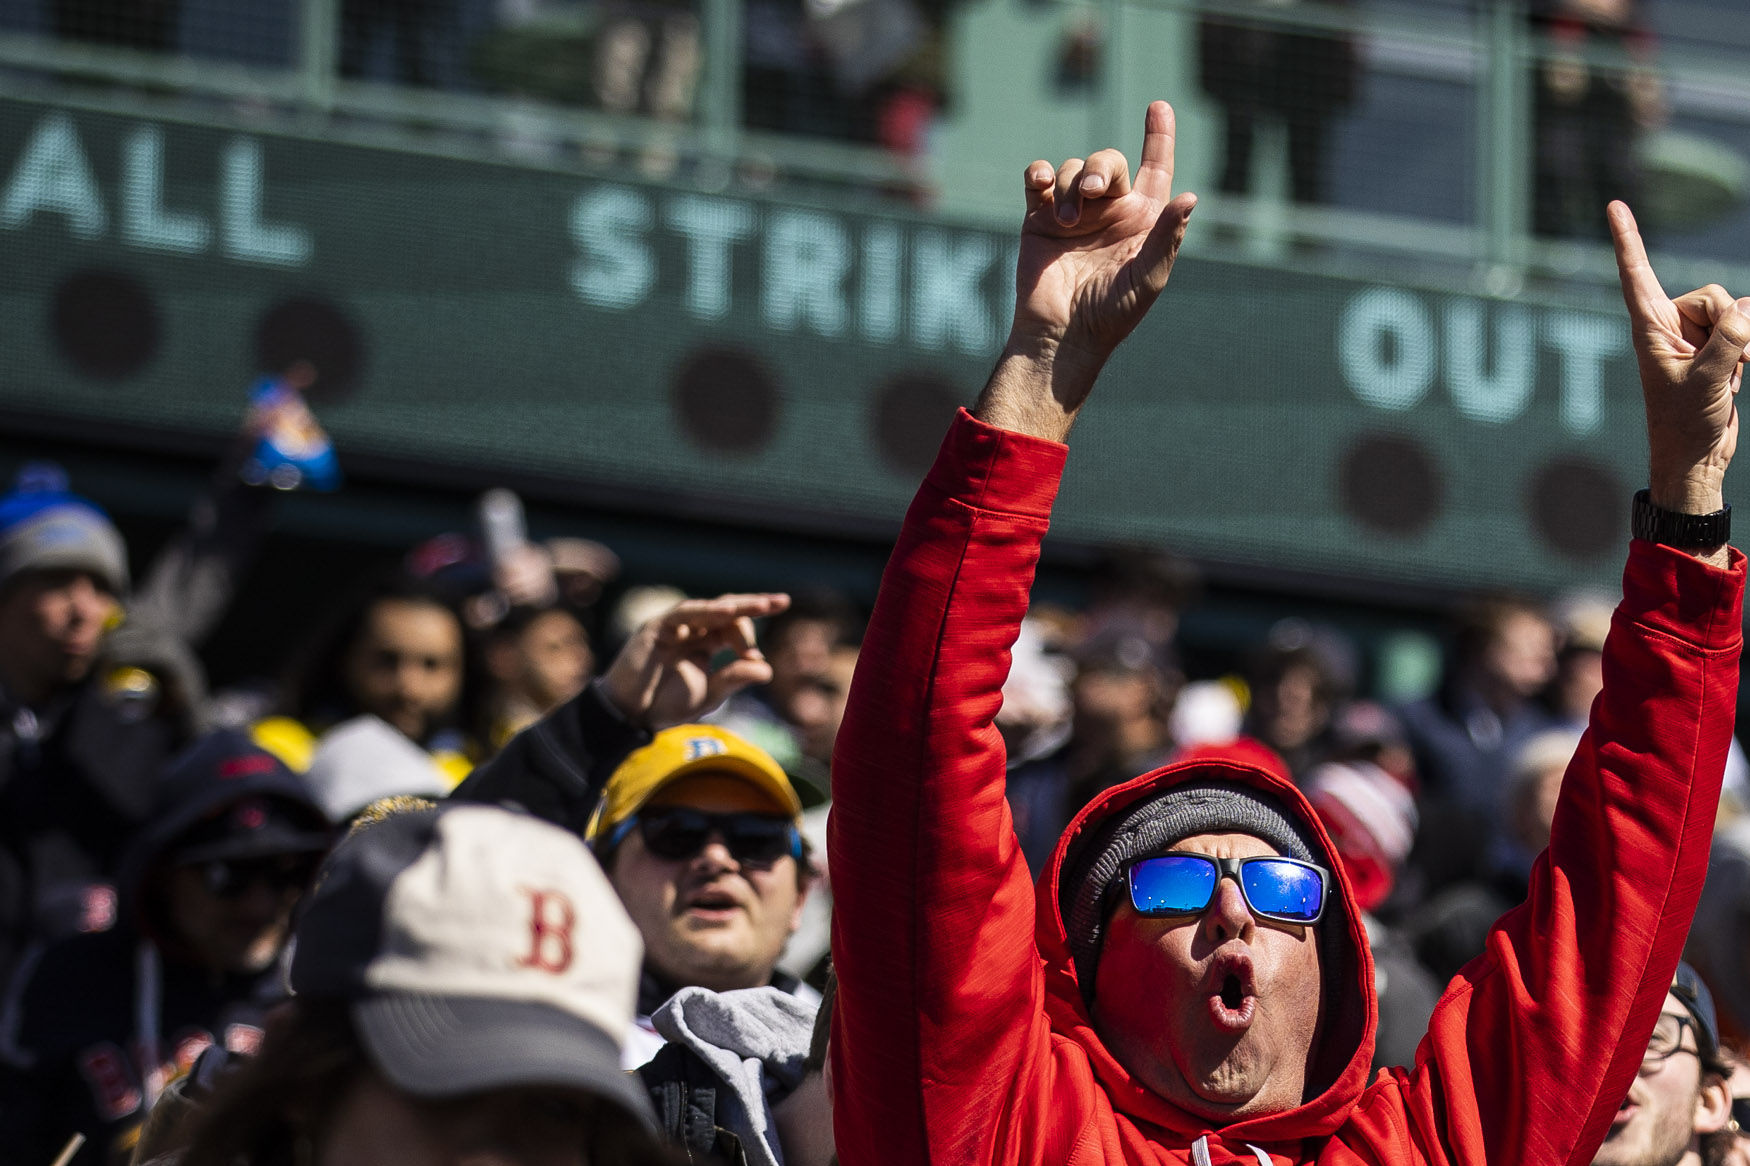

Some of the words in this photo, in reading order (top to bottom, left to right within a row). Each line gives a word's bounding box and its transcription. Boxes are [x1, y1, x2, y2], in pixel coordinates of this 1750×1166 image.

[568, 182, 1016, 357] STRIK
[1338, 284, 1632, 438] OUT
[513, 884, 577, 976] B
